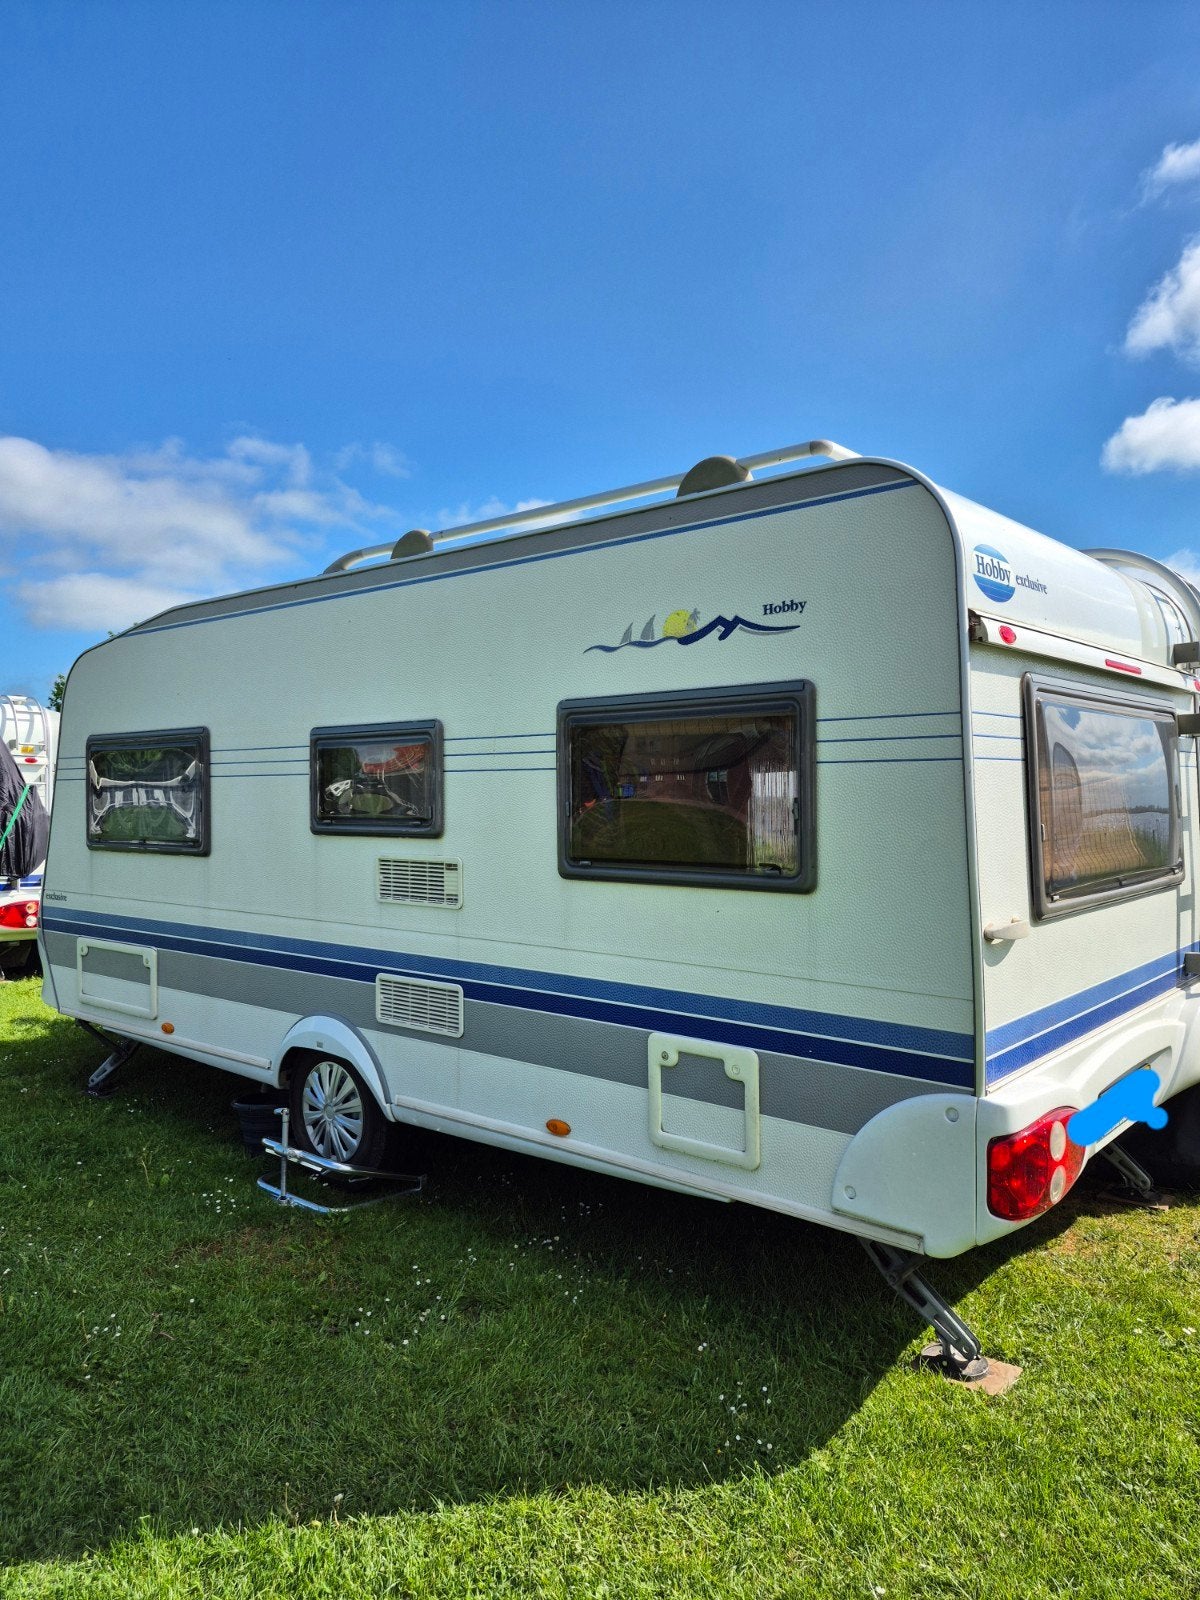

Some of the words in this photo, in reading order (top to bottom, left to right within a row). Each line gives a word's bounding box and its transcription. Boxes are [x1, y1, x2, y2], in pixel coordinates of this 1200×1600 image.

[975, 554, 1011, 587] Hobby
[1015, 575, 1048, 594] exclusive
[762, 599, 807, 615] Hobby
